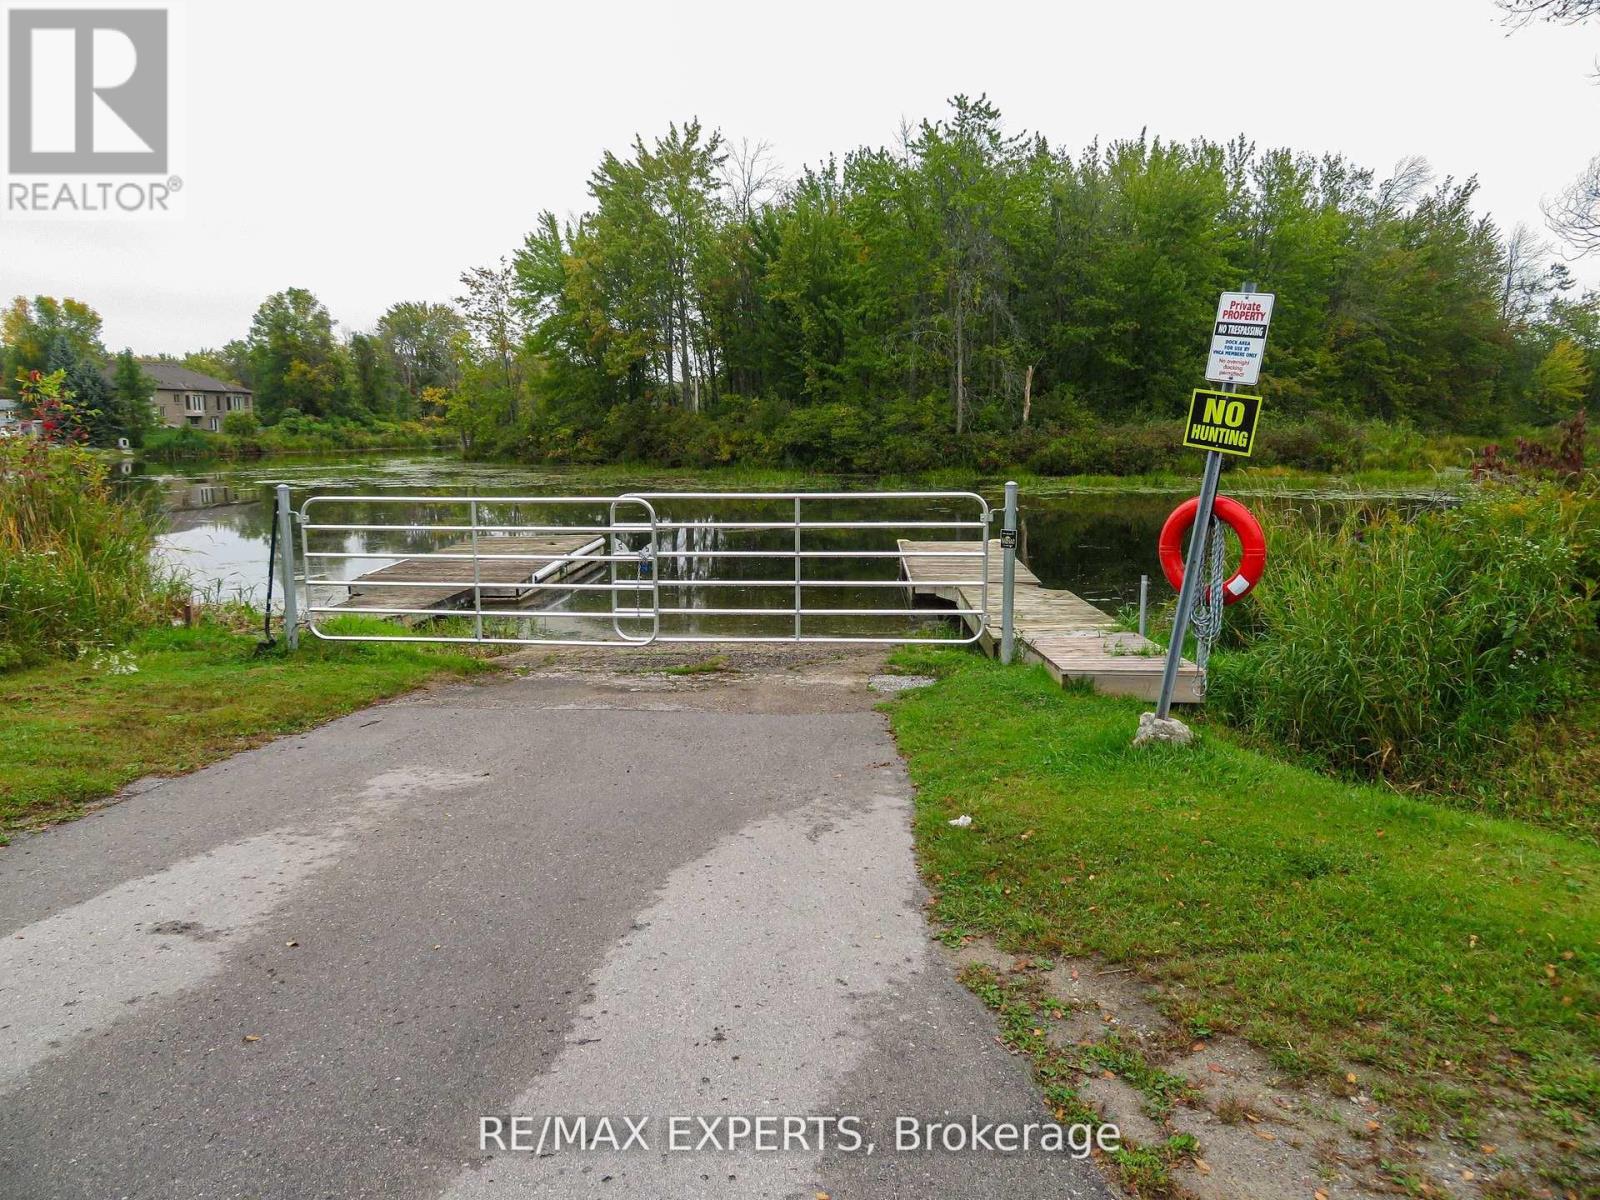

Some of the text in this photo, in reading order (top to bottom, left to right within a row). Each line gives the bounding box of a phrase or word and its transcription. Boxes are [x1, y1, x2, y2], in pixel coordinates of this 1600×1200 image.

[1229, 300, 1261, 311] Private
[1222, 310, 1266, 321] PROPERTY
[1217, 324, 1264, 336] NO TRESPASSING
[1203, 398, 1245, 427] NO
[1191, 424, 1248, 447] HUNTING
